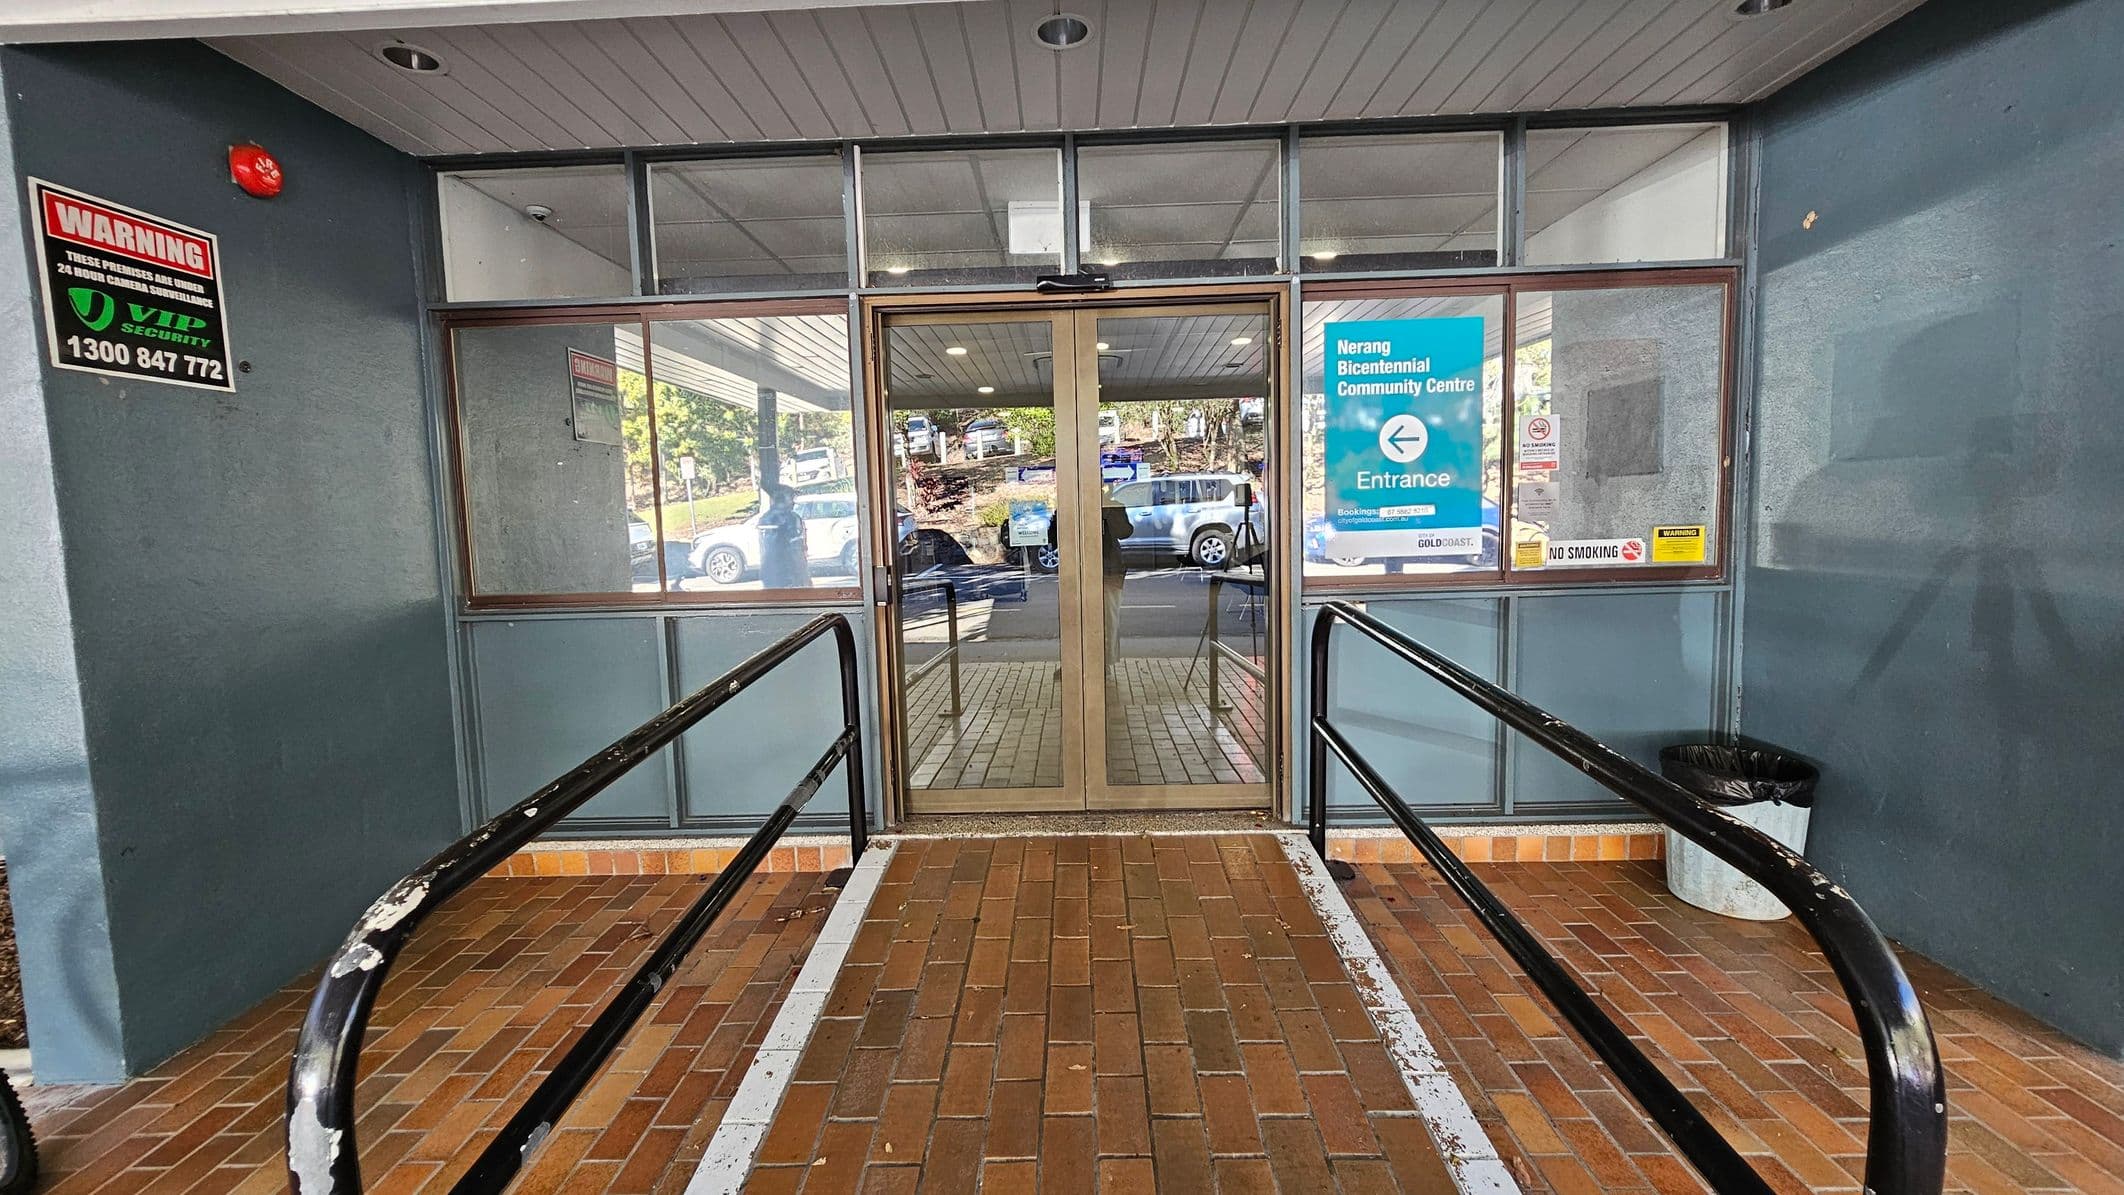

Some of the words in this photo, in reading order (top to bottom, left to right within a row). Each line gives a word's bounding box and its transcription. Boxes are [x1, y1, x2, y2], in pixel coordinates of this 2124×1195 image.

[55, 201, 205, 271] WARNING
[65, 250, 102, 268] THESE
[102, 260, 154, 281] PREMISES
[155, 273, 174, 286] ARE
[174, 278, 205, 294] UNDER
[56, 263, 73, 275] 24
[74, 267, 105, 283] HOUR
[106, 274, 149, 293] CAMERA
[149, 285, 214, 308] SURVEILLANCE
[127, 302, 207, 331] VIP
[121, 322, 212, 348] SECURITY
[67, 335, 130, 365] 1300
[136, 347, 178, 373] 847
[184, 355, 224, 380] 772
[1337, 339, 1391, 356] Nerang
[1337, 357, 1431, 376] Bicentennial
[1337, 379, 1423, 397] Community
[1426, 377, 1475, 393] Centre
[1357, 471, 1451, 490] Entrance
[1663, 529, 1697, 537] WARNING
[1549, 547, 1564, 560] NO
[1568, 545, 1619, 559] SMOKING
